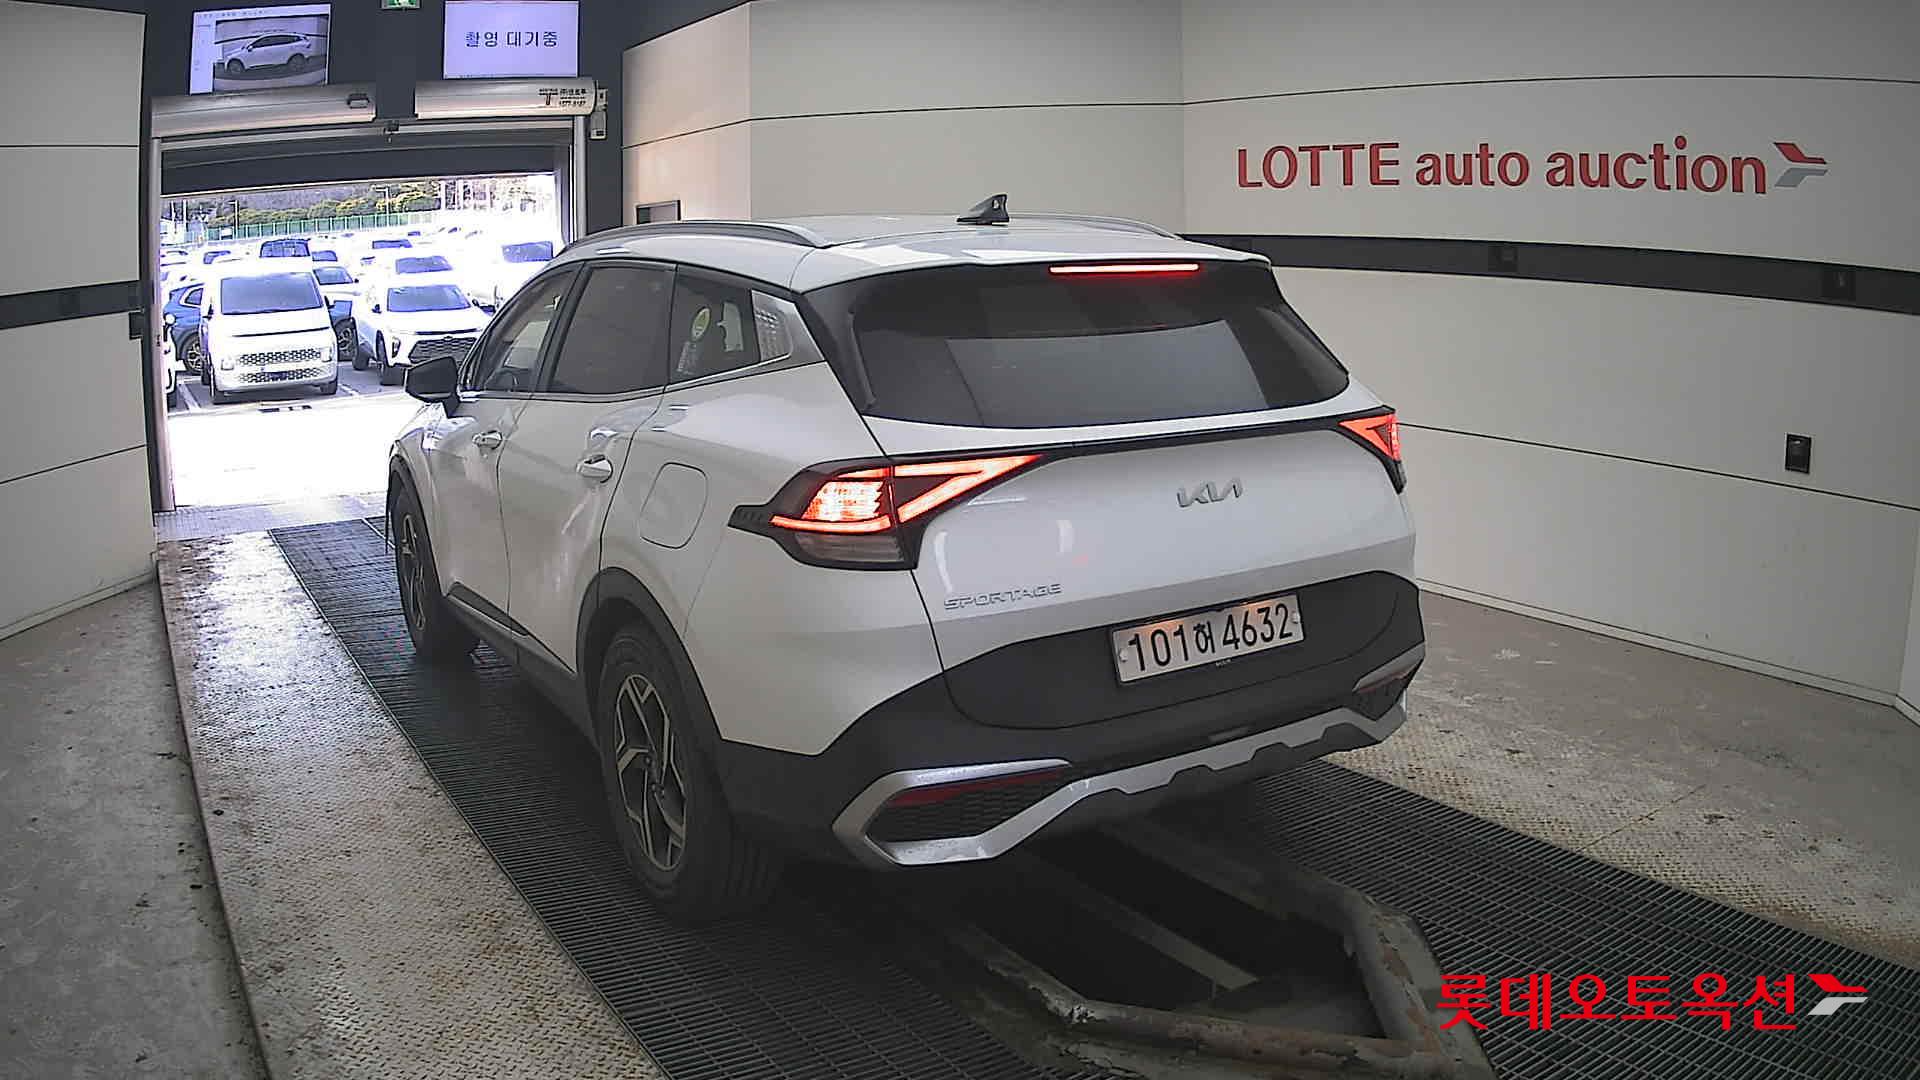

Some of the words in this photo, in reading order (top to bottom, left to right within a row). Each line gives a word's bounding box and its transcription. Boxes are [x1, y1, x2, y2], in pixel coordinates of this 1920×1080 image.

[506, 31, 558, 48] 대기중
[1237, 142, 1400, 188] LOTTE
[1415, 142, 1530, 188] auto
[1546, 136, 1767, 194] auction
[944, 583, 1062, 610] SPORTAGE
